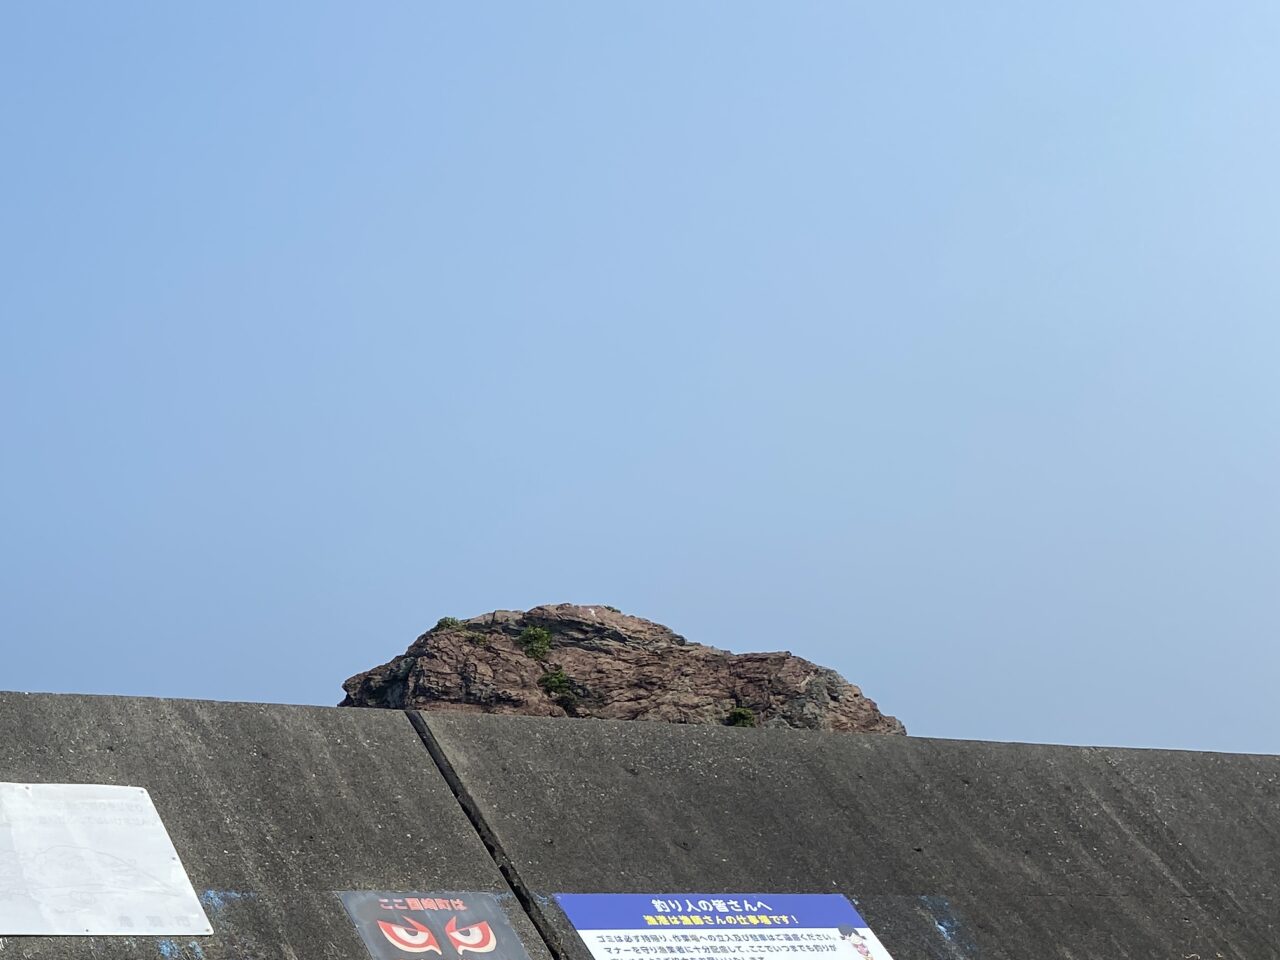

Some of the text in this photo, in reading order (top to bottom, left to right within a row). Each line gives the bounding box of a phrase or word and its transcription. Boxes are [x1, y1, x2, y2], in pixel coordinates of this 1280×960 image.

[652, 898, 773, 913] 釣り人の皆さんへ
